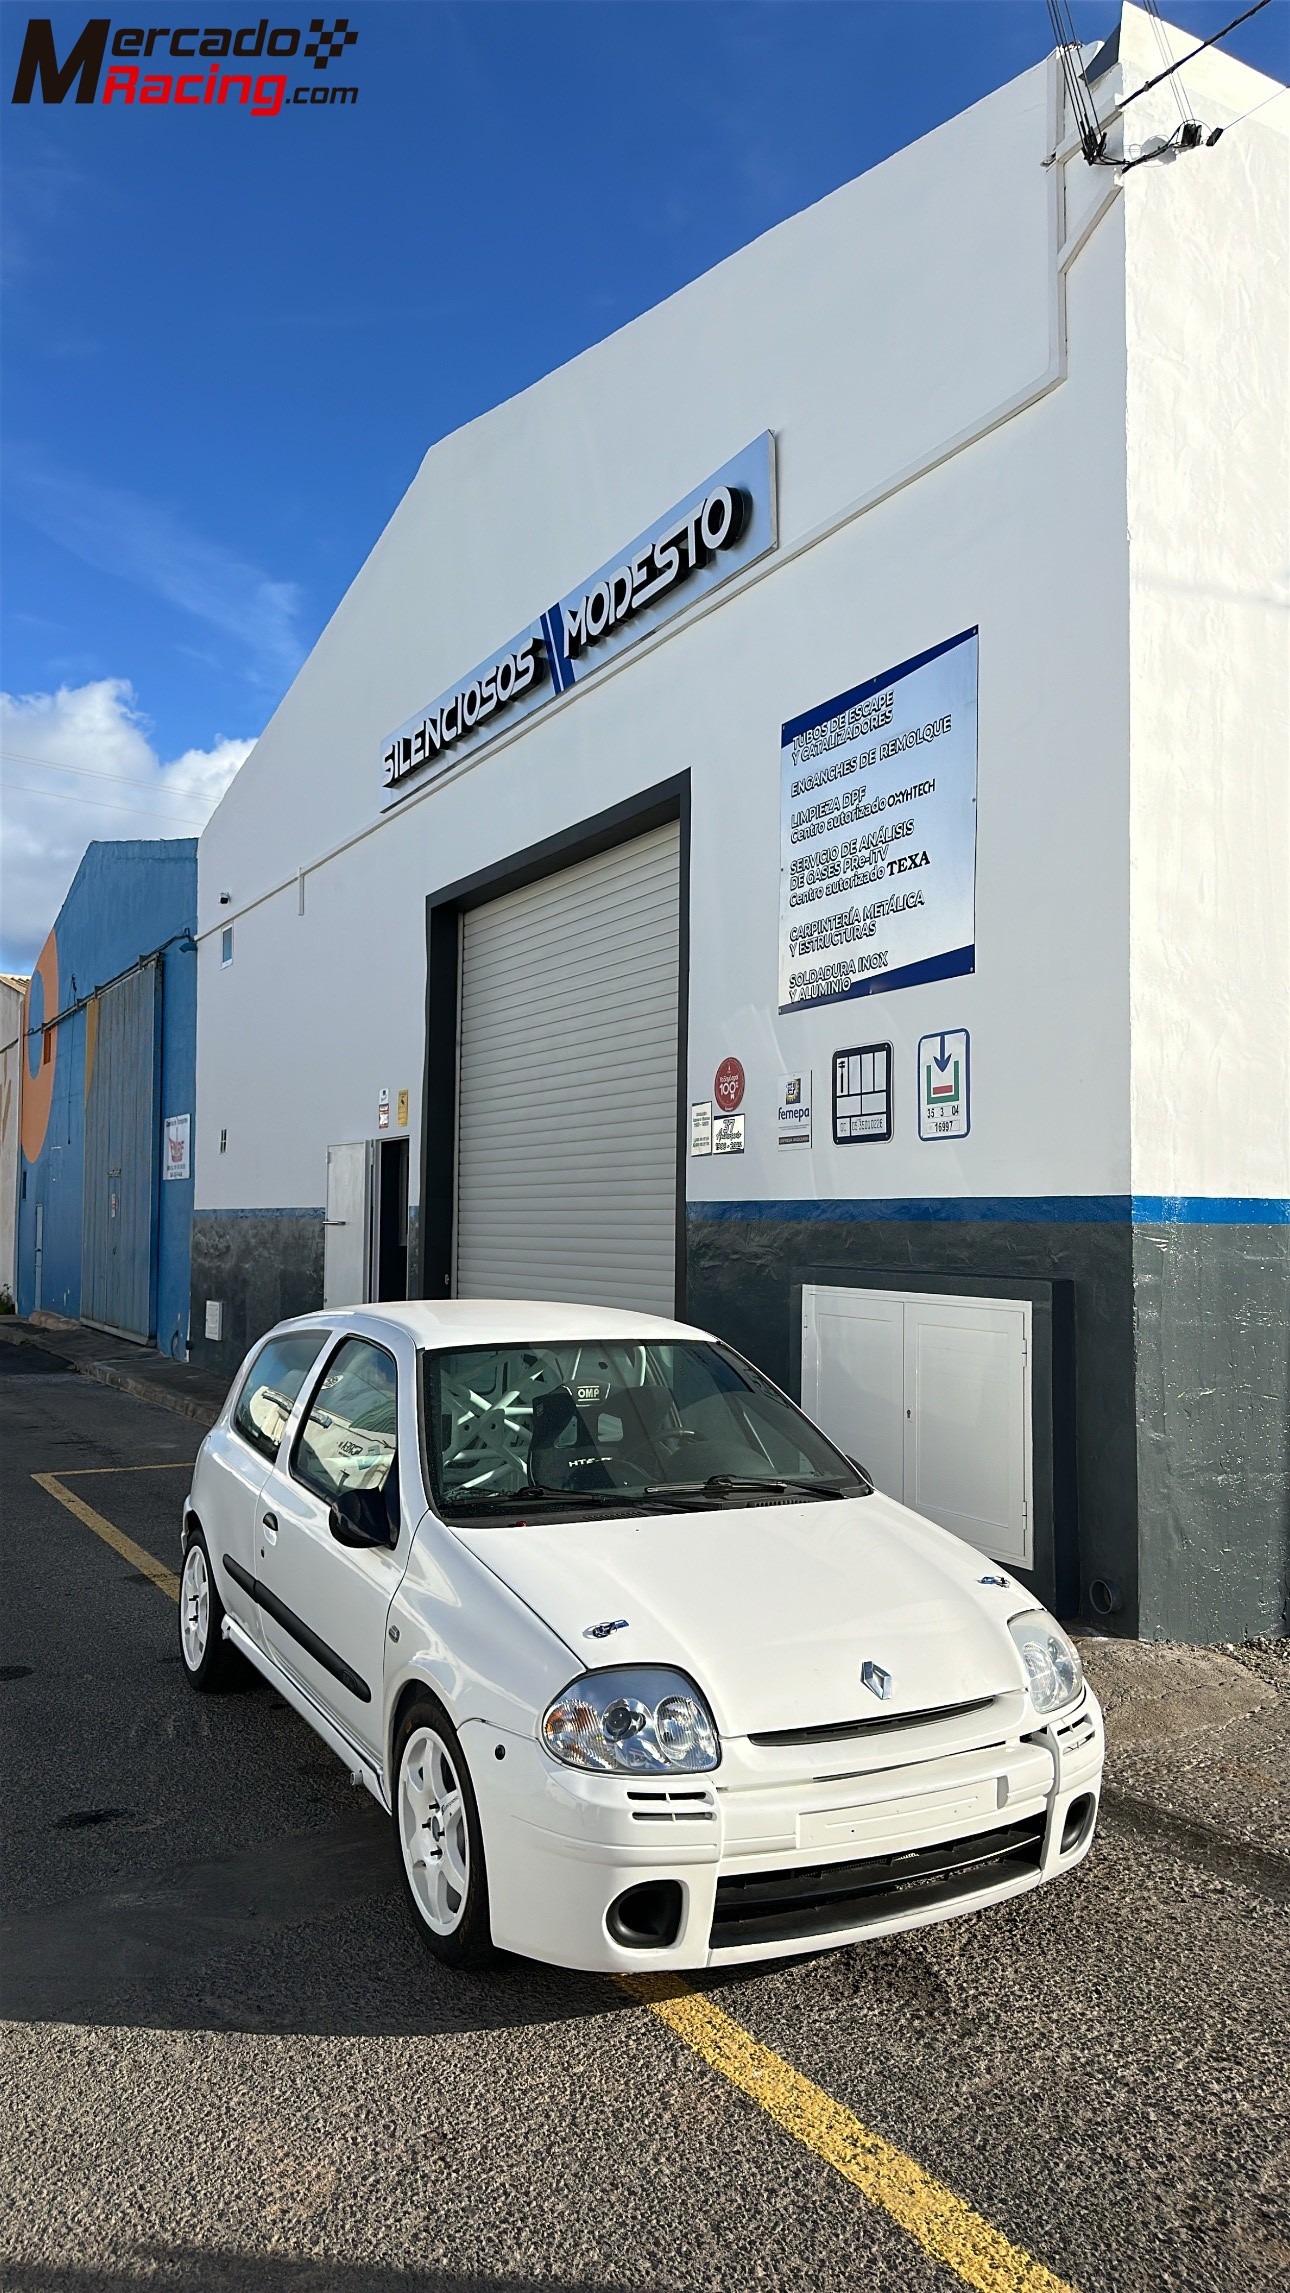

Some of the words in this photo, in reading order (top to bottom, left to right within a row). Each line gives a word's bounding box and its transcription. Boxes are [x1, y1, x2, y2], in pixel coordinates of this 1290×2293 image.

[382, 637, 544, 788] SILENCIOSOS
[563, 485, 748, 660] MODESTO
[791, 752, 799, 766] Y
[801, 707, 893, 762] CATALIZADORES
[792, 723, 828, 750] TUBOS
[830, 715, 846, 731] DE
[848, 689, 894, 725] ESCAPE
[791, 757, 857, 798] ENGANCHES
[859, 749, 877, 769] DE
[879, 714, 951, 760] REMOLQUE
[791, 797, 841, 829] LIMPIEZA
[842, 785, 866, 809] DPF
[791, 821, 825, 844] Centro
[826, 797, 887, 831] autorizado
[887, 779, 936, 808] OXYHTECH
[790, 847, 839, 875] SERVICIO
[840, 841, 857, 858] DE
[858, 819, 914, 851] ANÁLISIS
[789, 888, 824, 907] Centro
[825, 865, 885, 897] autorizado
[886, 850, 931, 877] TEXA
[790, 874, 805, 891] DE
[806, 861, 841, 886] GASES
[789, 906, 861, 942] CARPINTERÍA
[862, 889, 925, 921] METÁLICA
[789, 943, 798, 957] Y
[798, 920, 877, 955] ESTRUCTURAS
[788, 959, 856, 990] SOLDADURA
[857, 951, 889, 972] INOX
[788, 989, 798, 1003] Y
[798, 977, 851, 1001] ALUMINIO
[778, 1107, 809, 1122] femepa
[927, 1107, 935, 1118] 35
[577, 1388, 600, 1398] OMP
